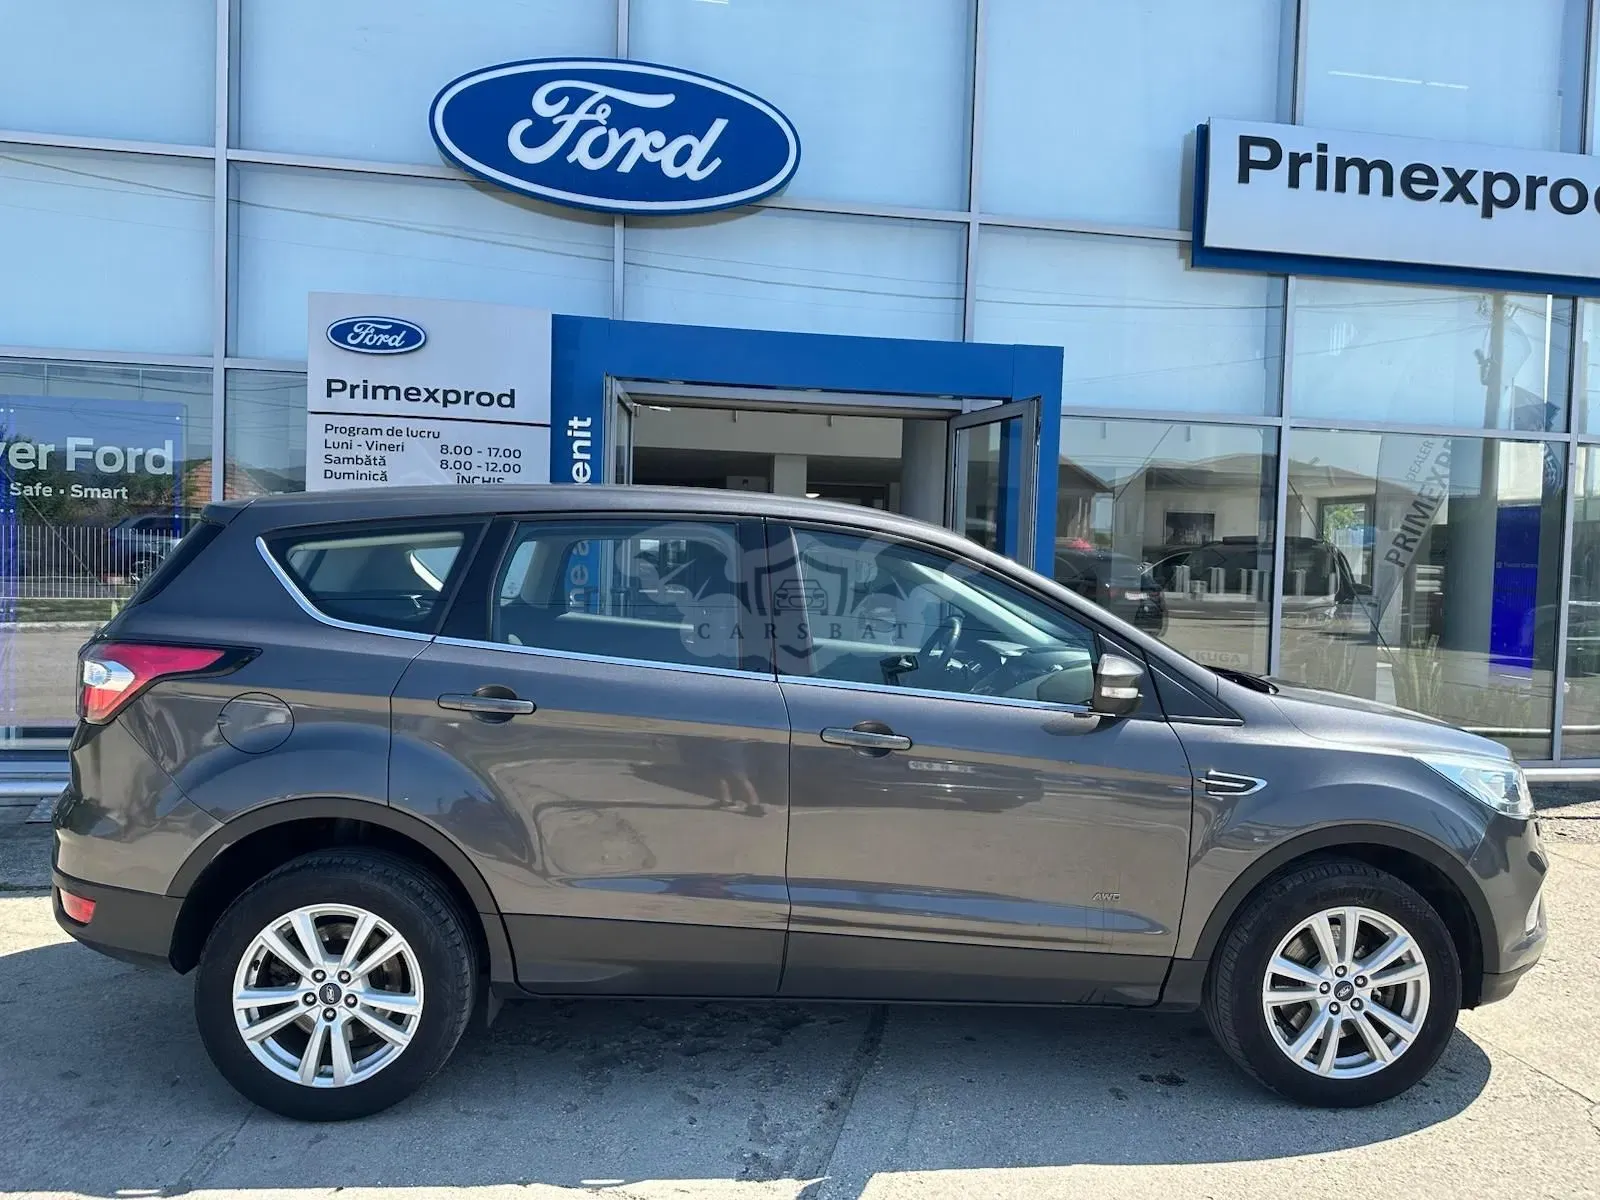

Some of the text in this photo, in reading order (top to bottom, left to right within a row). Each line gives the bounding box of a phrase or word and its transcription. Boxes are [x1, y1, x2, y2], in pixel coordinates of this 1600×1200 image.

[507, 79, 729, 182] Ford
[346, 321, 407, 348] Ford
[326, 378, 516, 409] Primexprod
[324, 423, 441, 439] Program de lucru
[324, 439, 353, 450] Luni
[365, 440, 405, 452] Vineri
[440, 444, 473, 456] 8.00
[487, 447, 522, 459] 17.00
[567, 416, 592, 484] enit
[66, 436, 174, 476] Ford
[324, 454, 387, 467] Sambătă
[1405, 440, 1435, 481] DEALER
[440, 459, 473, 471] 8.00
[485, 462, 522, 474] 12.00
[324, 469, 388, 482] Duminică
[9, 482, 129, 500] Safe Smart
[1196, 652, 1241, 665] KUGA
